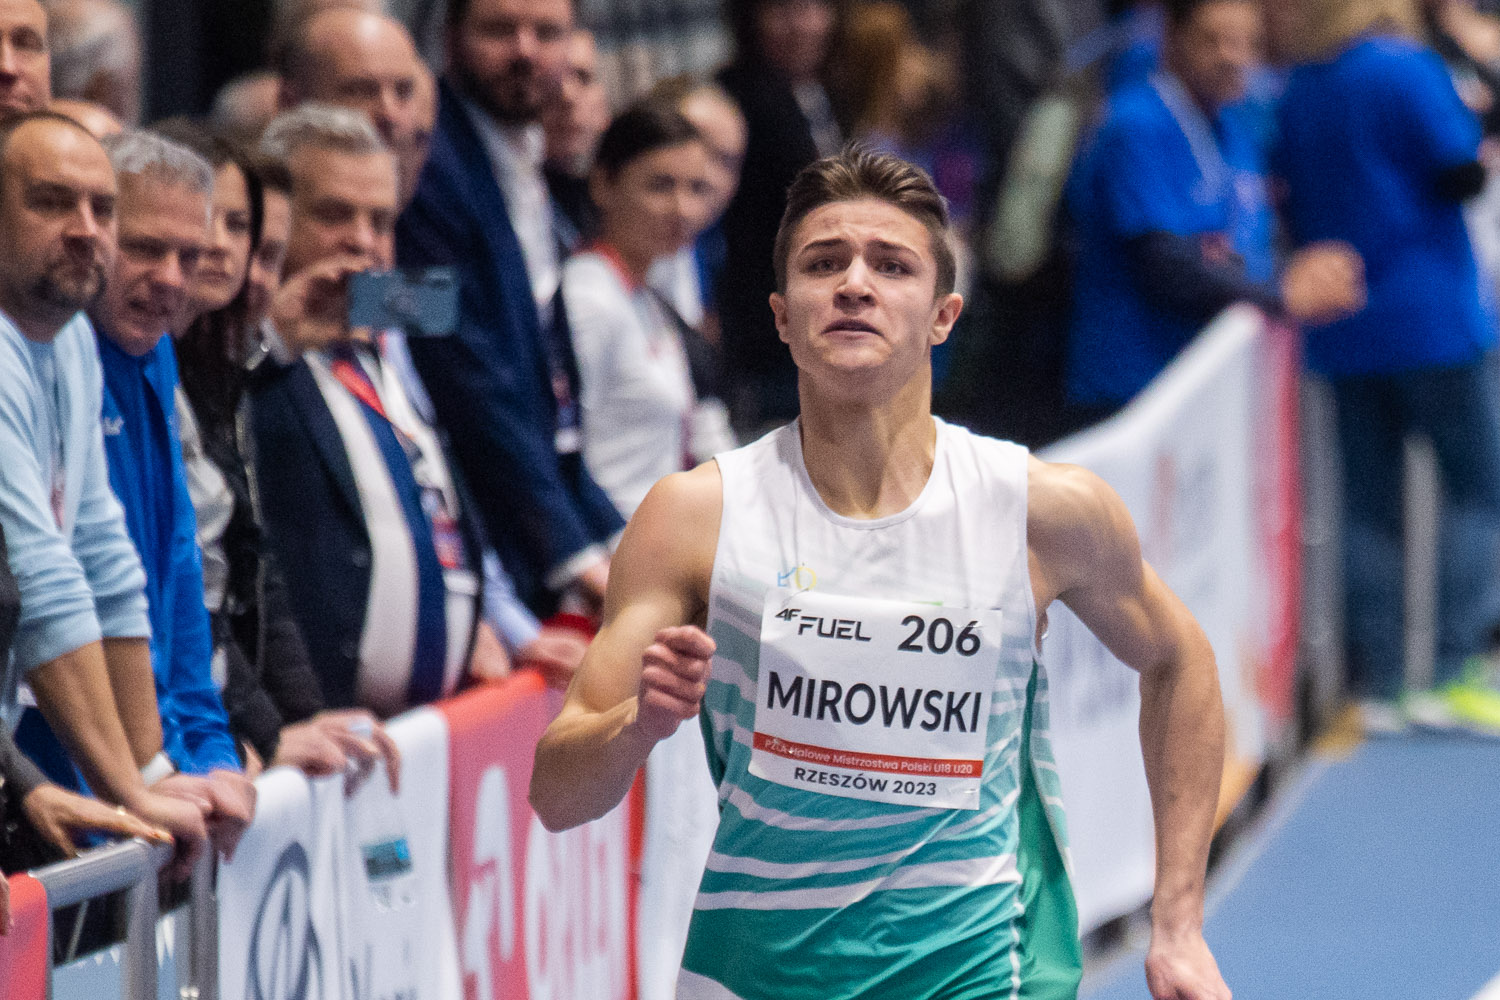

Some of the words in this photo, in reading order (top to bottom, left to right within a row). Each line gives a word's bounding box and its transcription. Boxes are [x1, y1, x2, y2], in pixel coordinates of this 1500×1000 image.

[798, 616, 872, 643] FUEL
[897, 615, 982, 657] 206
[766, 671, 982, 734] MIROWSKI
[794, 766, 888, 793] RZESZÓW
[893, 779, 937, 797] 2023
[832, 755, 899, 772] Mistrzostwa
[901, 761, 933, 774] Polski
[934, 763, 951, 774] U18
[953, 764, 974, 775] U20
